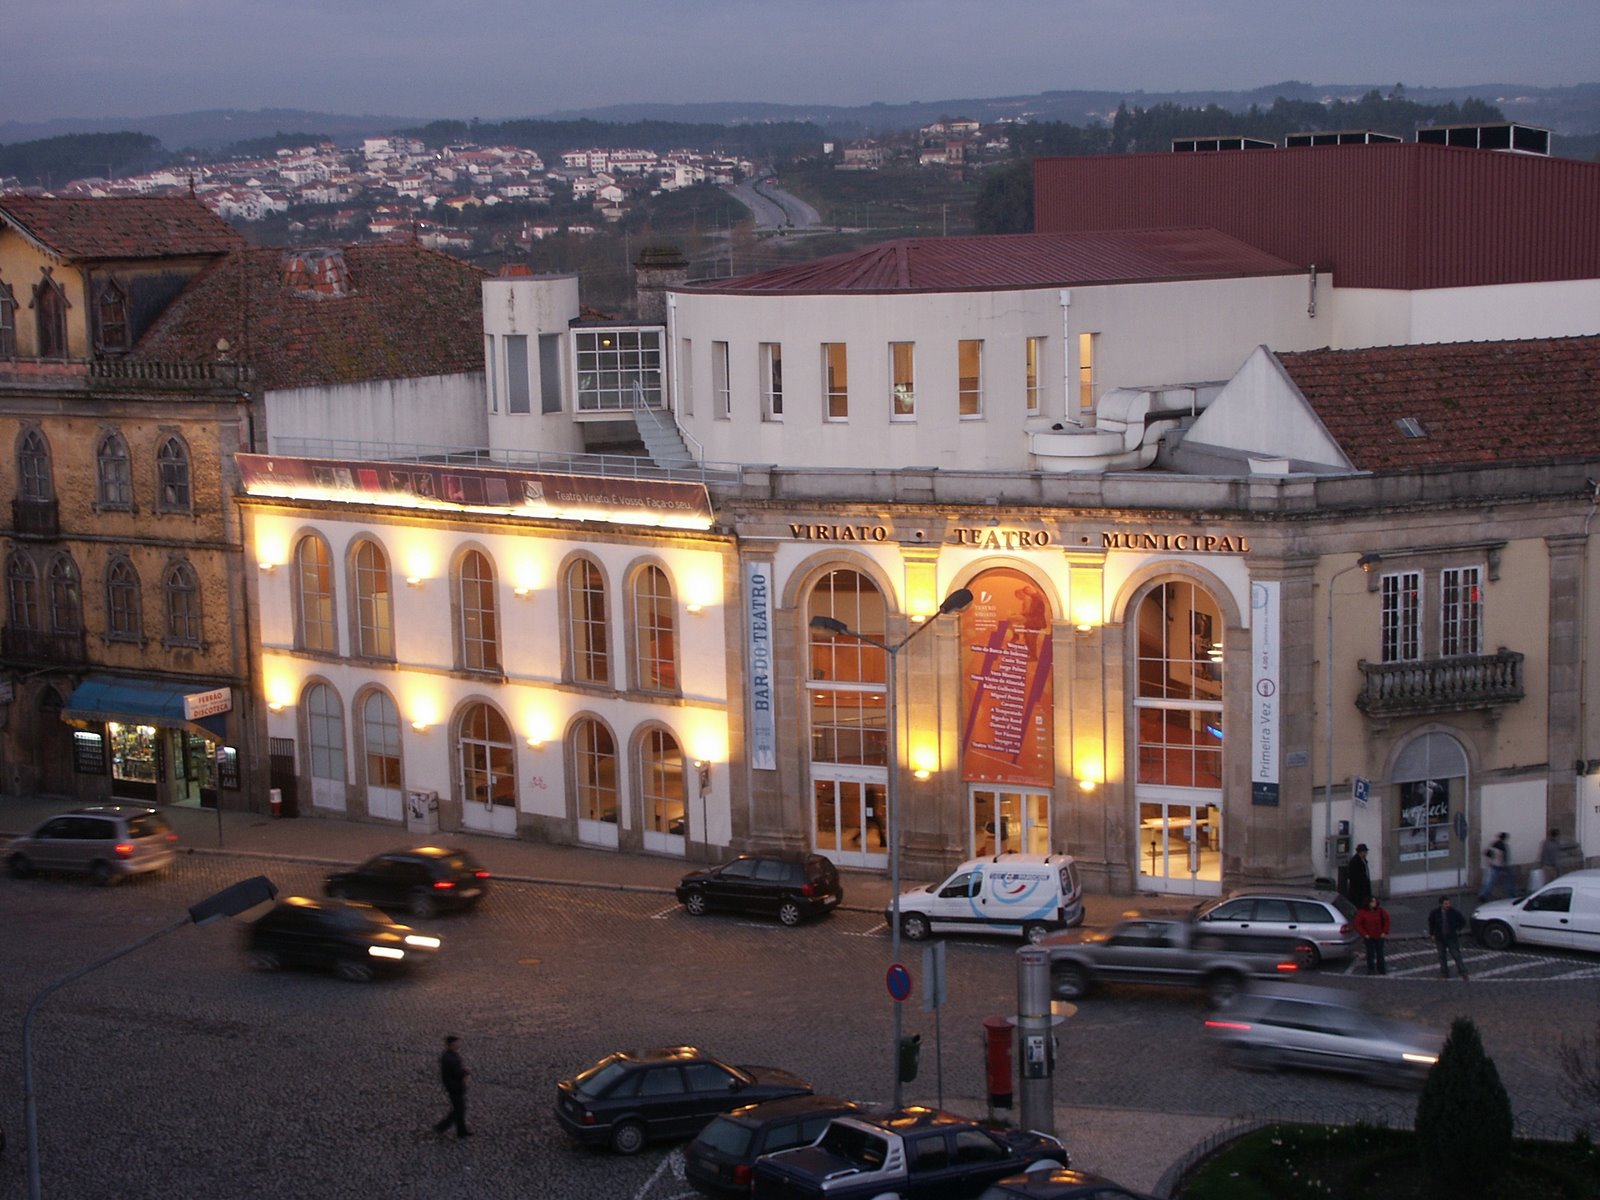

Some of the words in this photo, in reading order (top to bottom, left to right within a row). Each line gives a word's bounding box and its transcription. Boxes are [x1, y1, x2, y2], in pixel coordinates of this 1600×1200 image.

[555, 491, 581, 502] Teatro
[612, 493, 618, 504] É
[646, 497, 674, 509] Faça-o
[789, 524, 887, 541] VIRIATO
[954, 528, 1049, 546] TEATRO
[1102, 532, 1250, 552] MUNICIPAL
[751, 574, 767, 643] TEATRO
[753, 647, 768, 670] DO
[754, 674, 769, 712] BAR
[193, 703, 229, 717] DISCOTECA
[1260, 703, 1271, 724] Vez
[1260, 728, 1271, 778] Primeira
